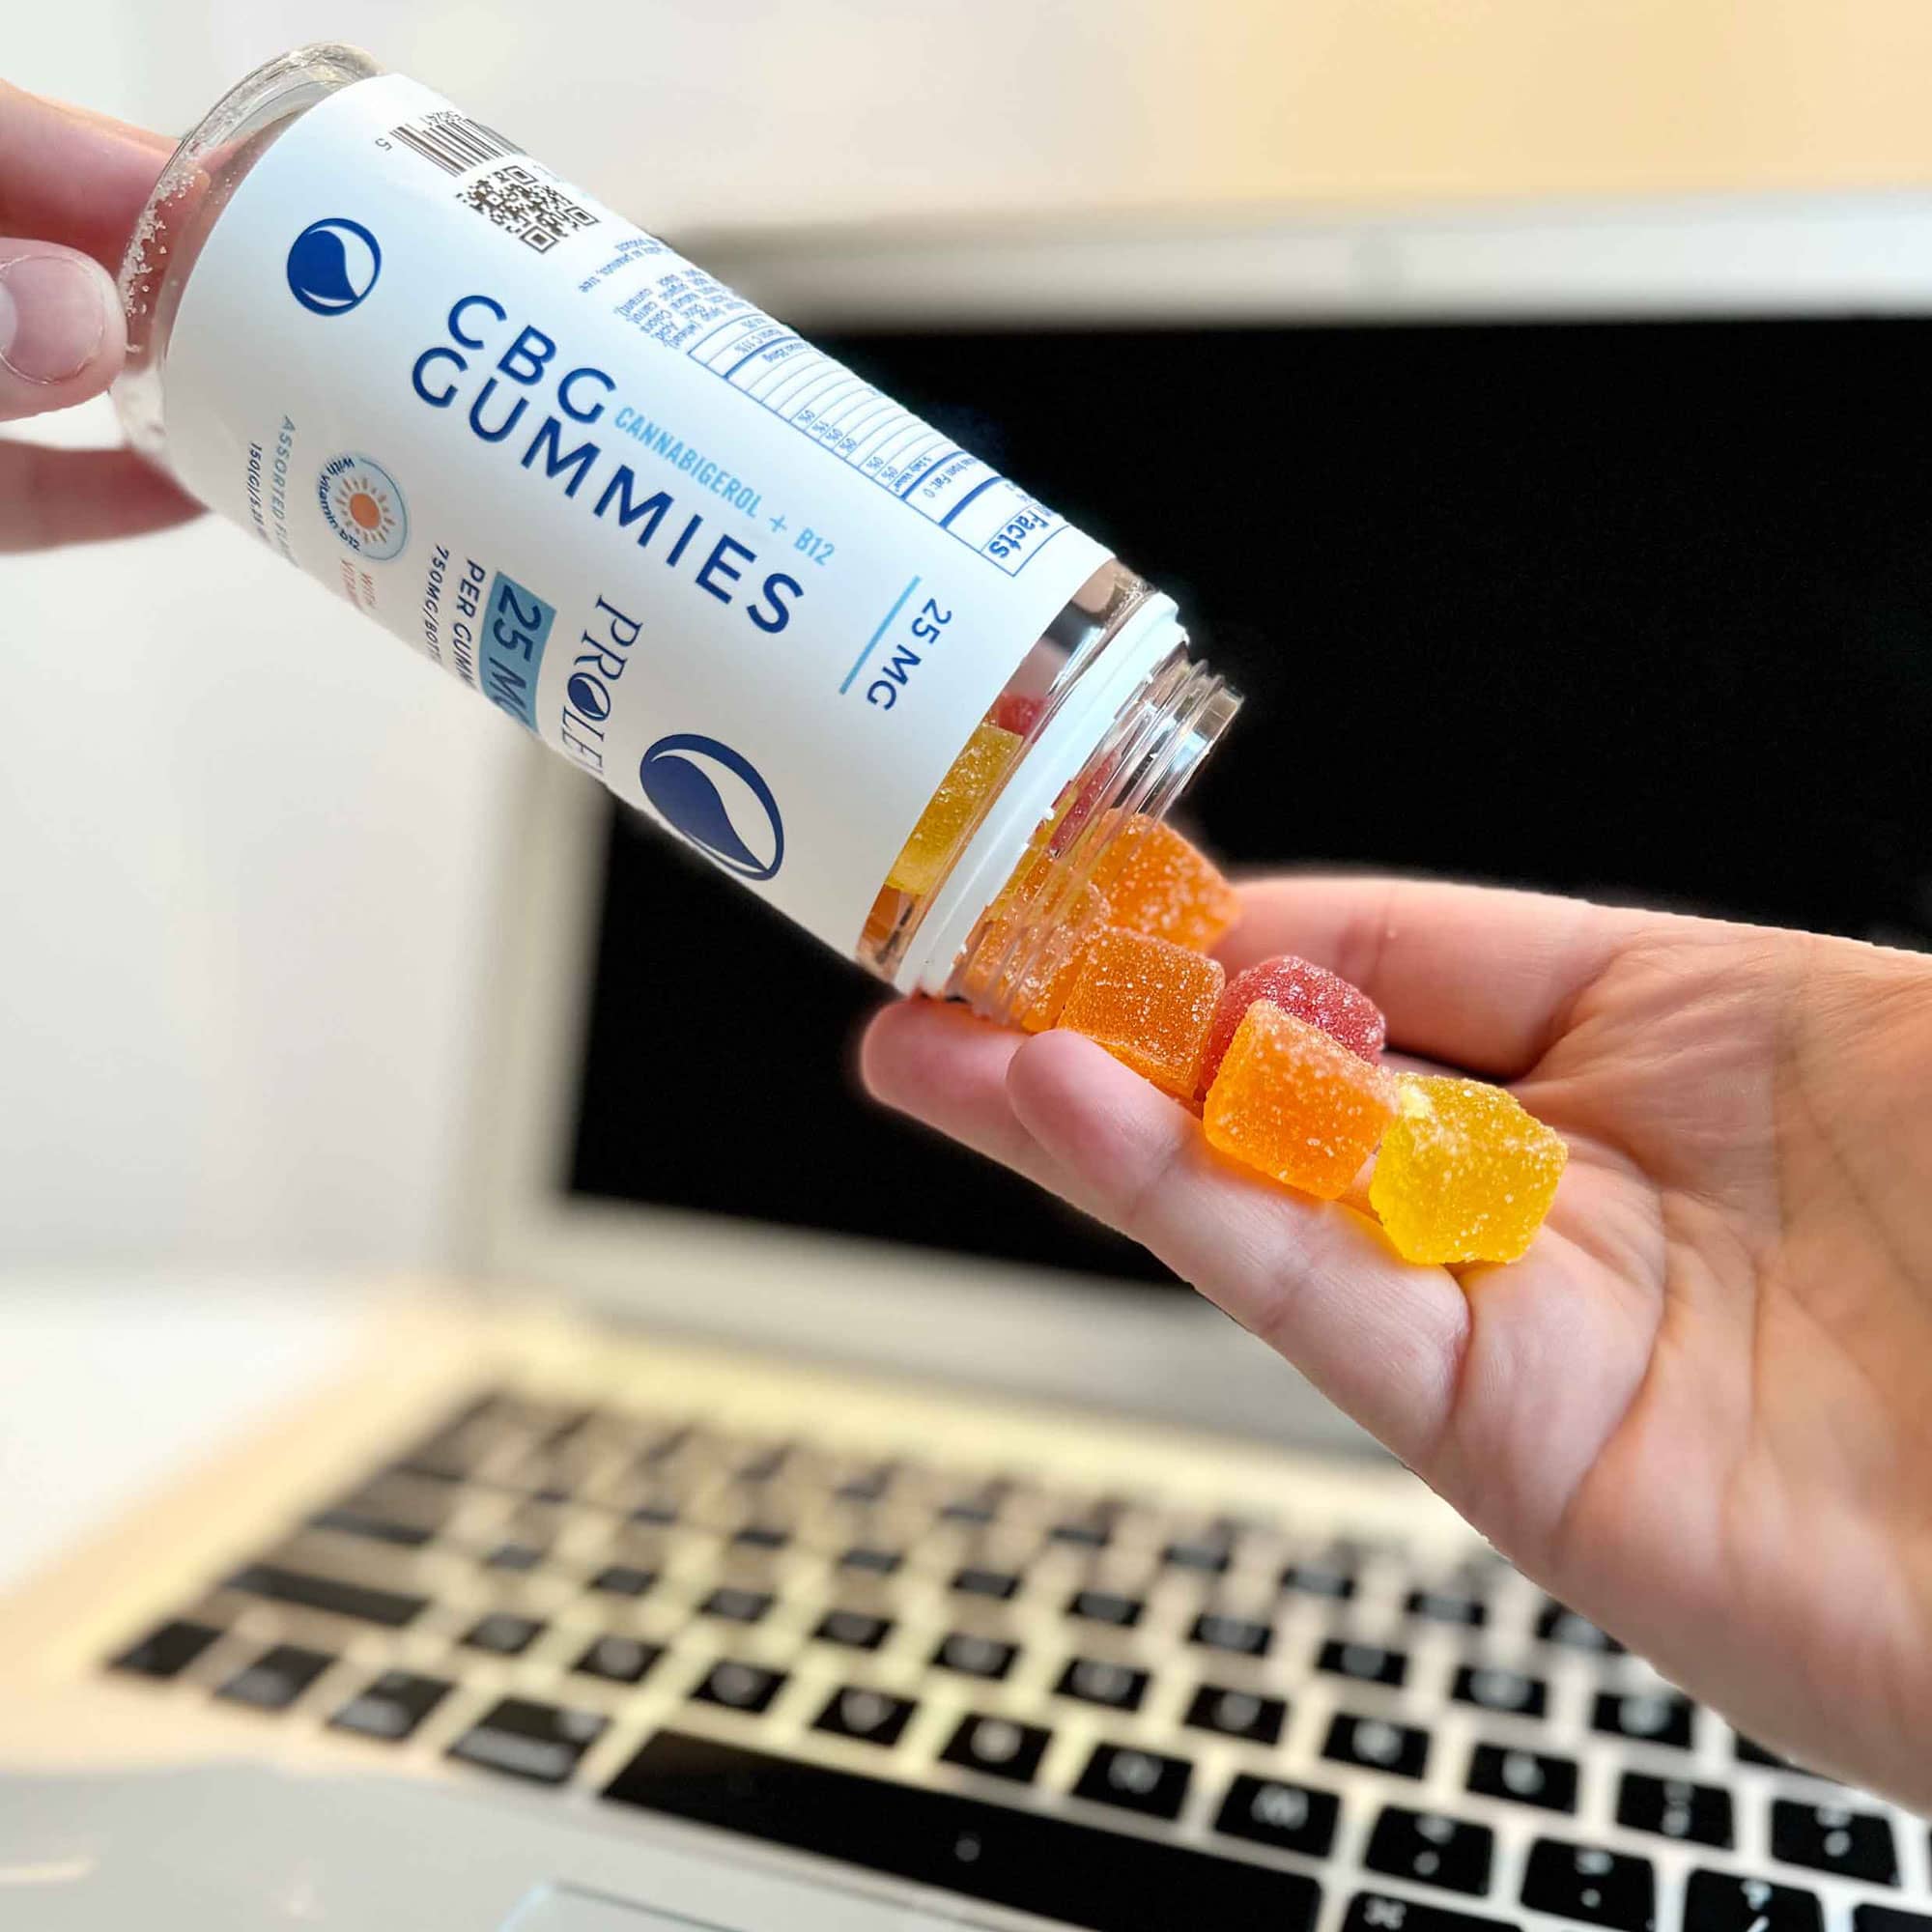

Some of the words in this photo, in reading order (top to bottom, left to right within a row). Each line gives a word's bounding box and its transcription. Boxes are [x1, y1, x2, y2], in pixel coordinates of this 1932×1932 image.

[447, 295, 616, 425] CBG
[270, 414, 297, 521] ASSORTED
[412, 347, 805, 634] GUMMIES
[614, 407, 763, 519] CANNABIGEROL
[769, 514, 788, 534] +
[794, 526, 836, 567] B12
[988, 510, 1050, 558] Facts
[456, 557, 487, 619] PER
[492, 584, 543, 663] 25
[912, 598, 952, 644] 25
[867, 644, 922, 711] MG
